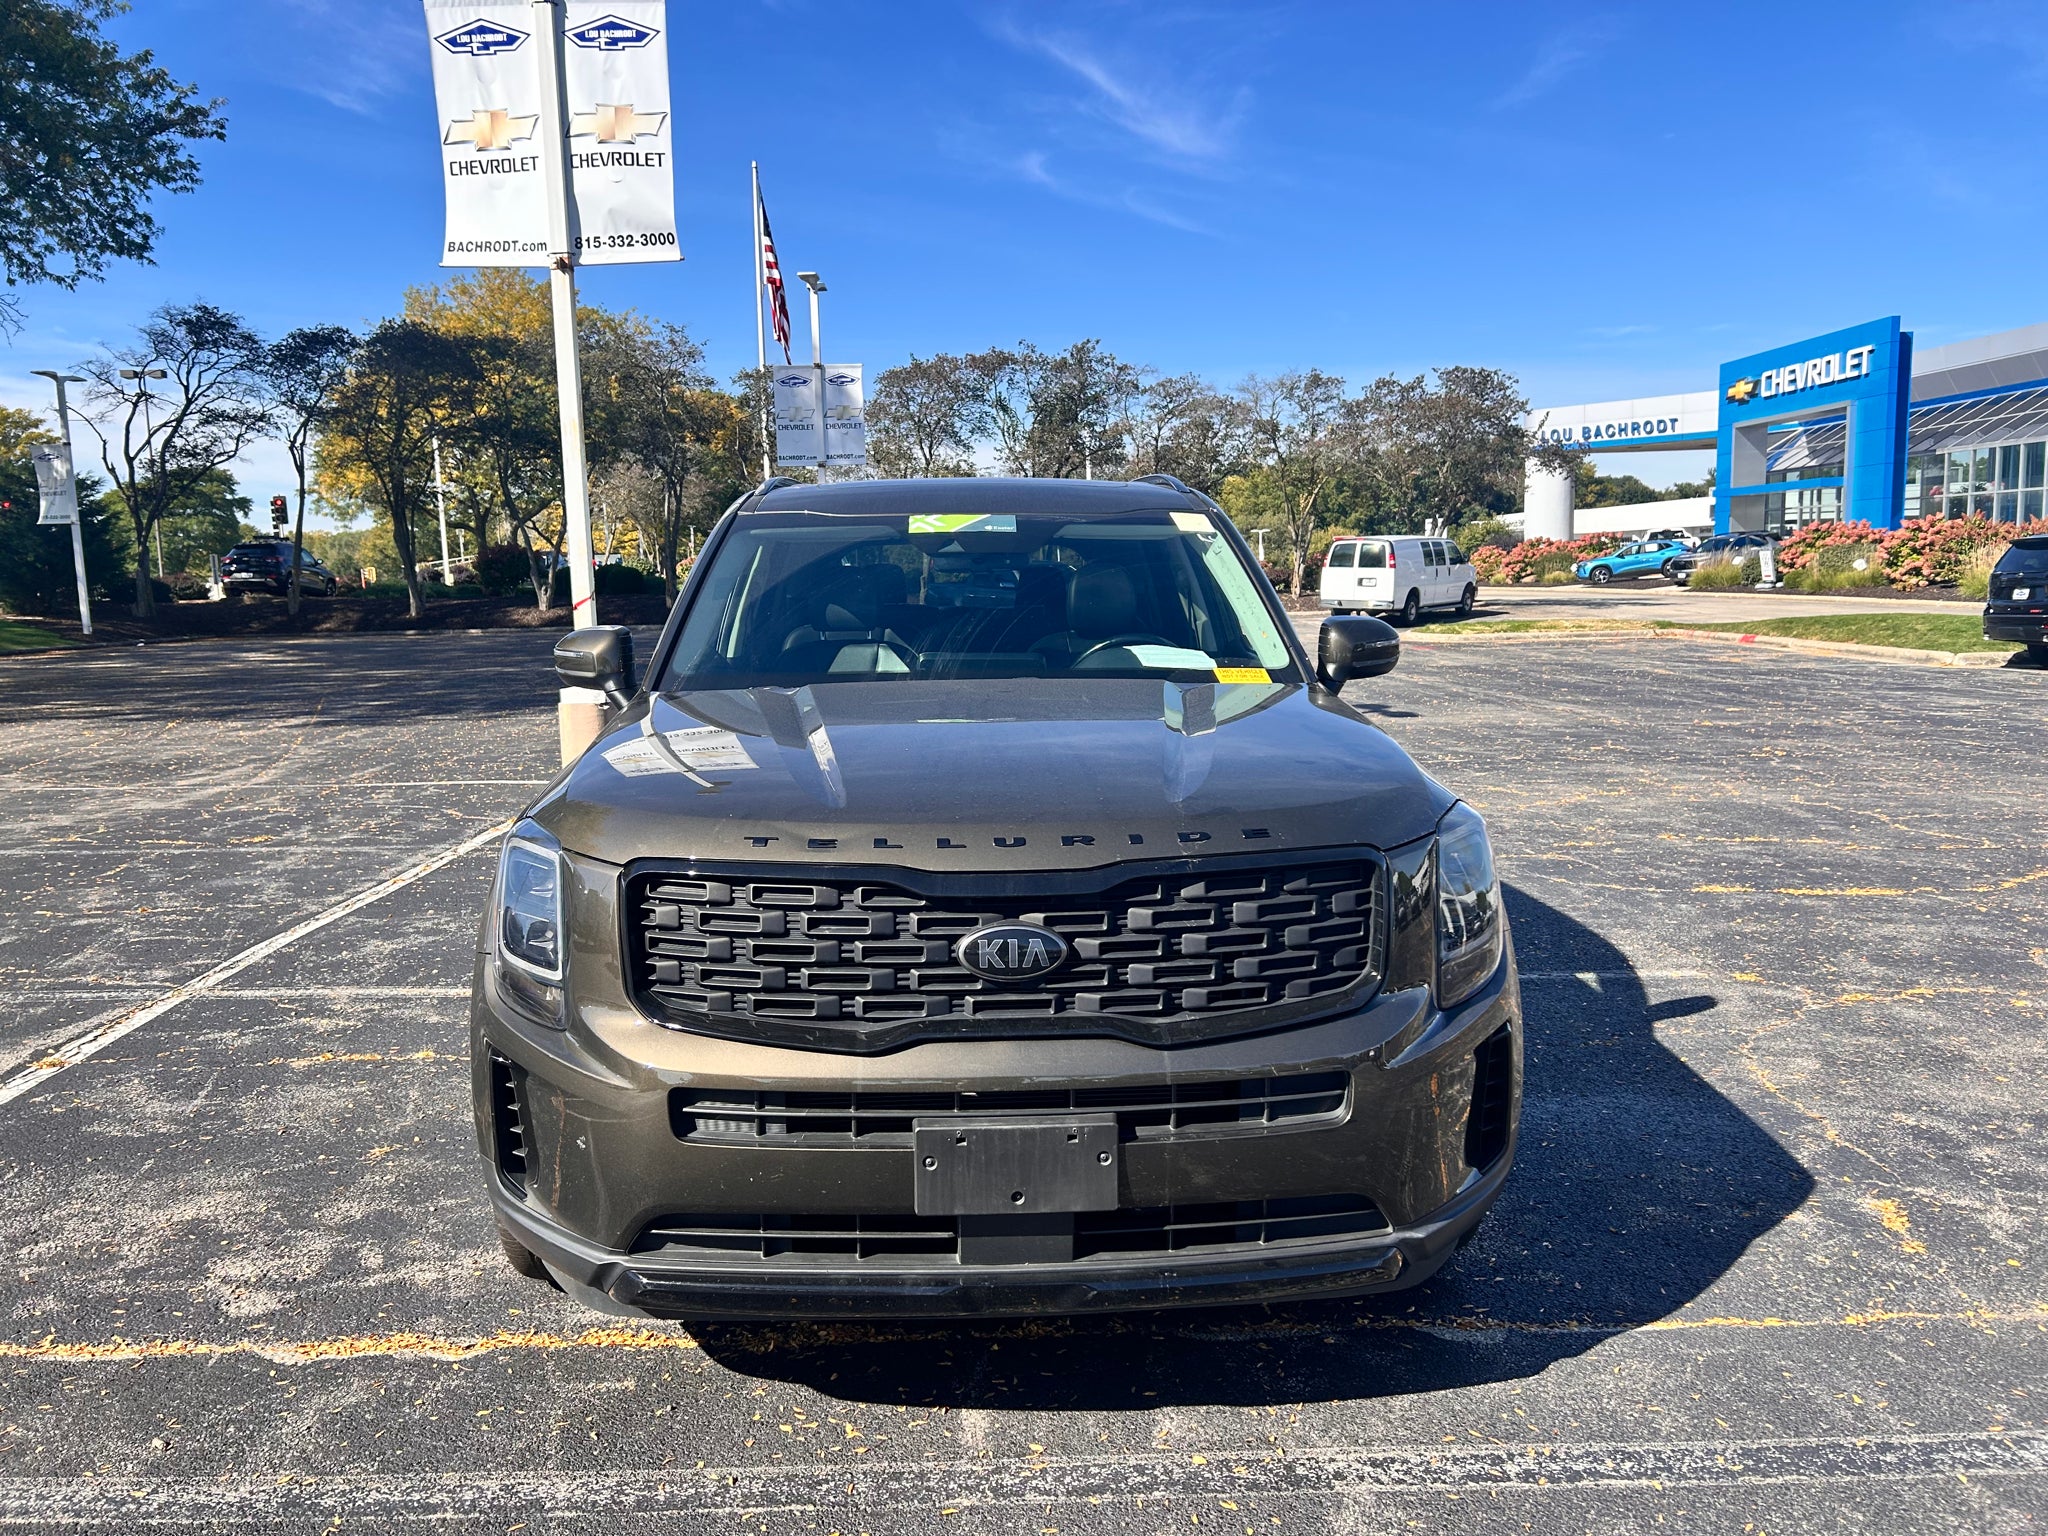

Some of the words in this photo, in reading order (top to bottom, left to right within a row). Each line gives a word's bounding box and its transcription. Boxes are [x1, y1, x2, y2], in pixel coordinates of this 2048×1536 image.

[456, 34, 470, 43] LOU
[471, 33, 507, 43] BACHRODT
[584, 30, 599, 38] LOU
[600, 29, 637, 38] BACHRODT
[449, 156, 539, 177] CHEVROLET
[570, 151, 666, 169] CHEVROLET
[447, 240, 548, 253] BACHRODT.com
[574, 232, 676, 250] 815-332-3000
[1760, 344, 1876, 398] CHEVROLET
[1540, 427, 1573, 443] LOU
[1582, 418, 1679, 441] BACHRODT
[744, 827, 1272, 849] TELLURIDE
[978, 938, 1050, 968] KIA
